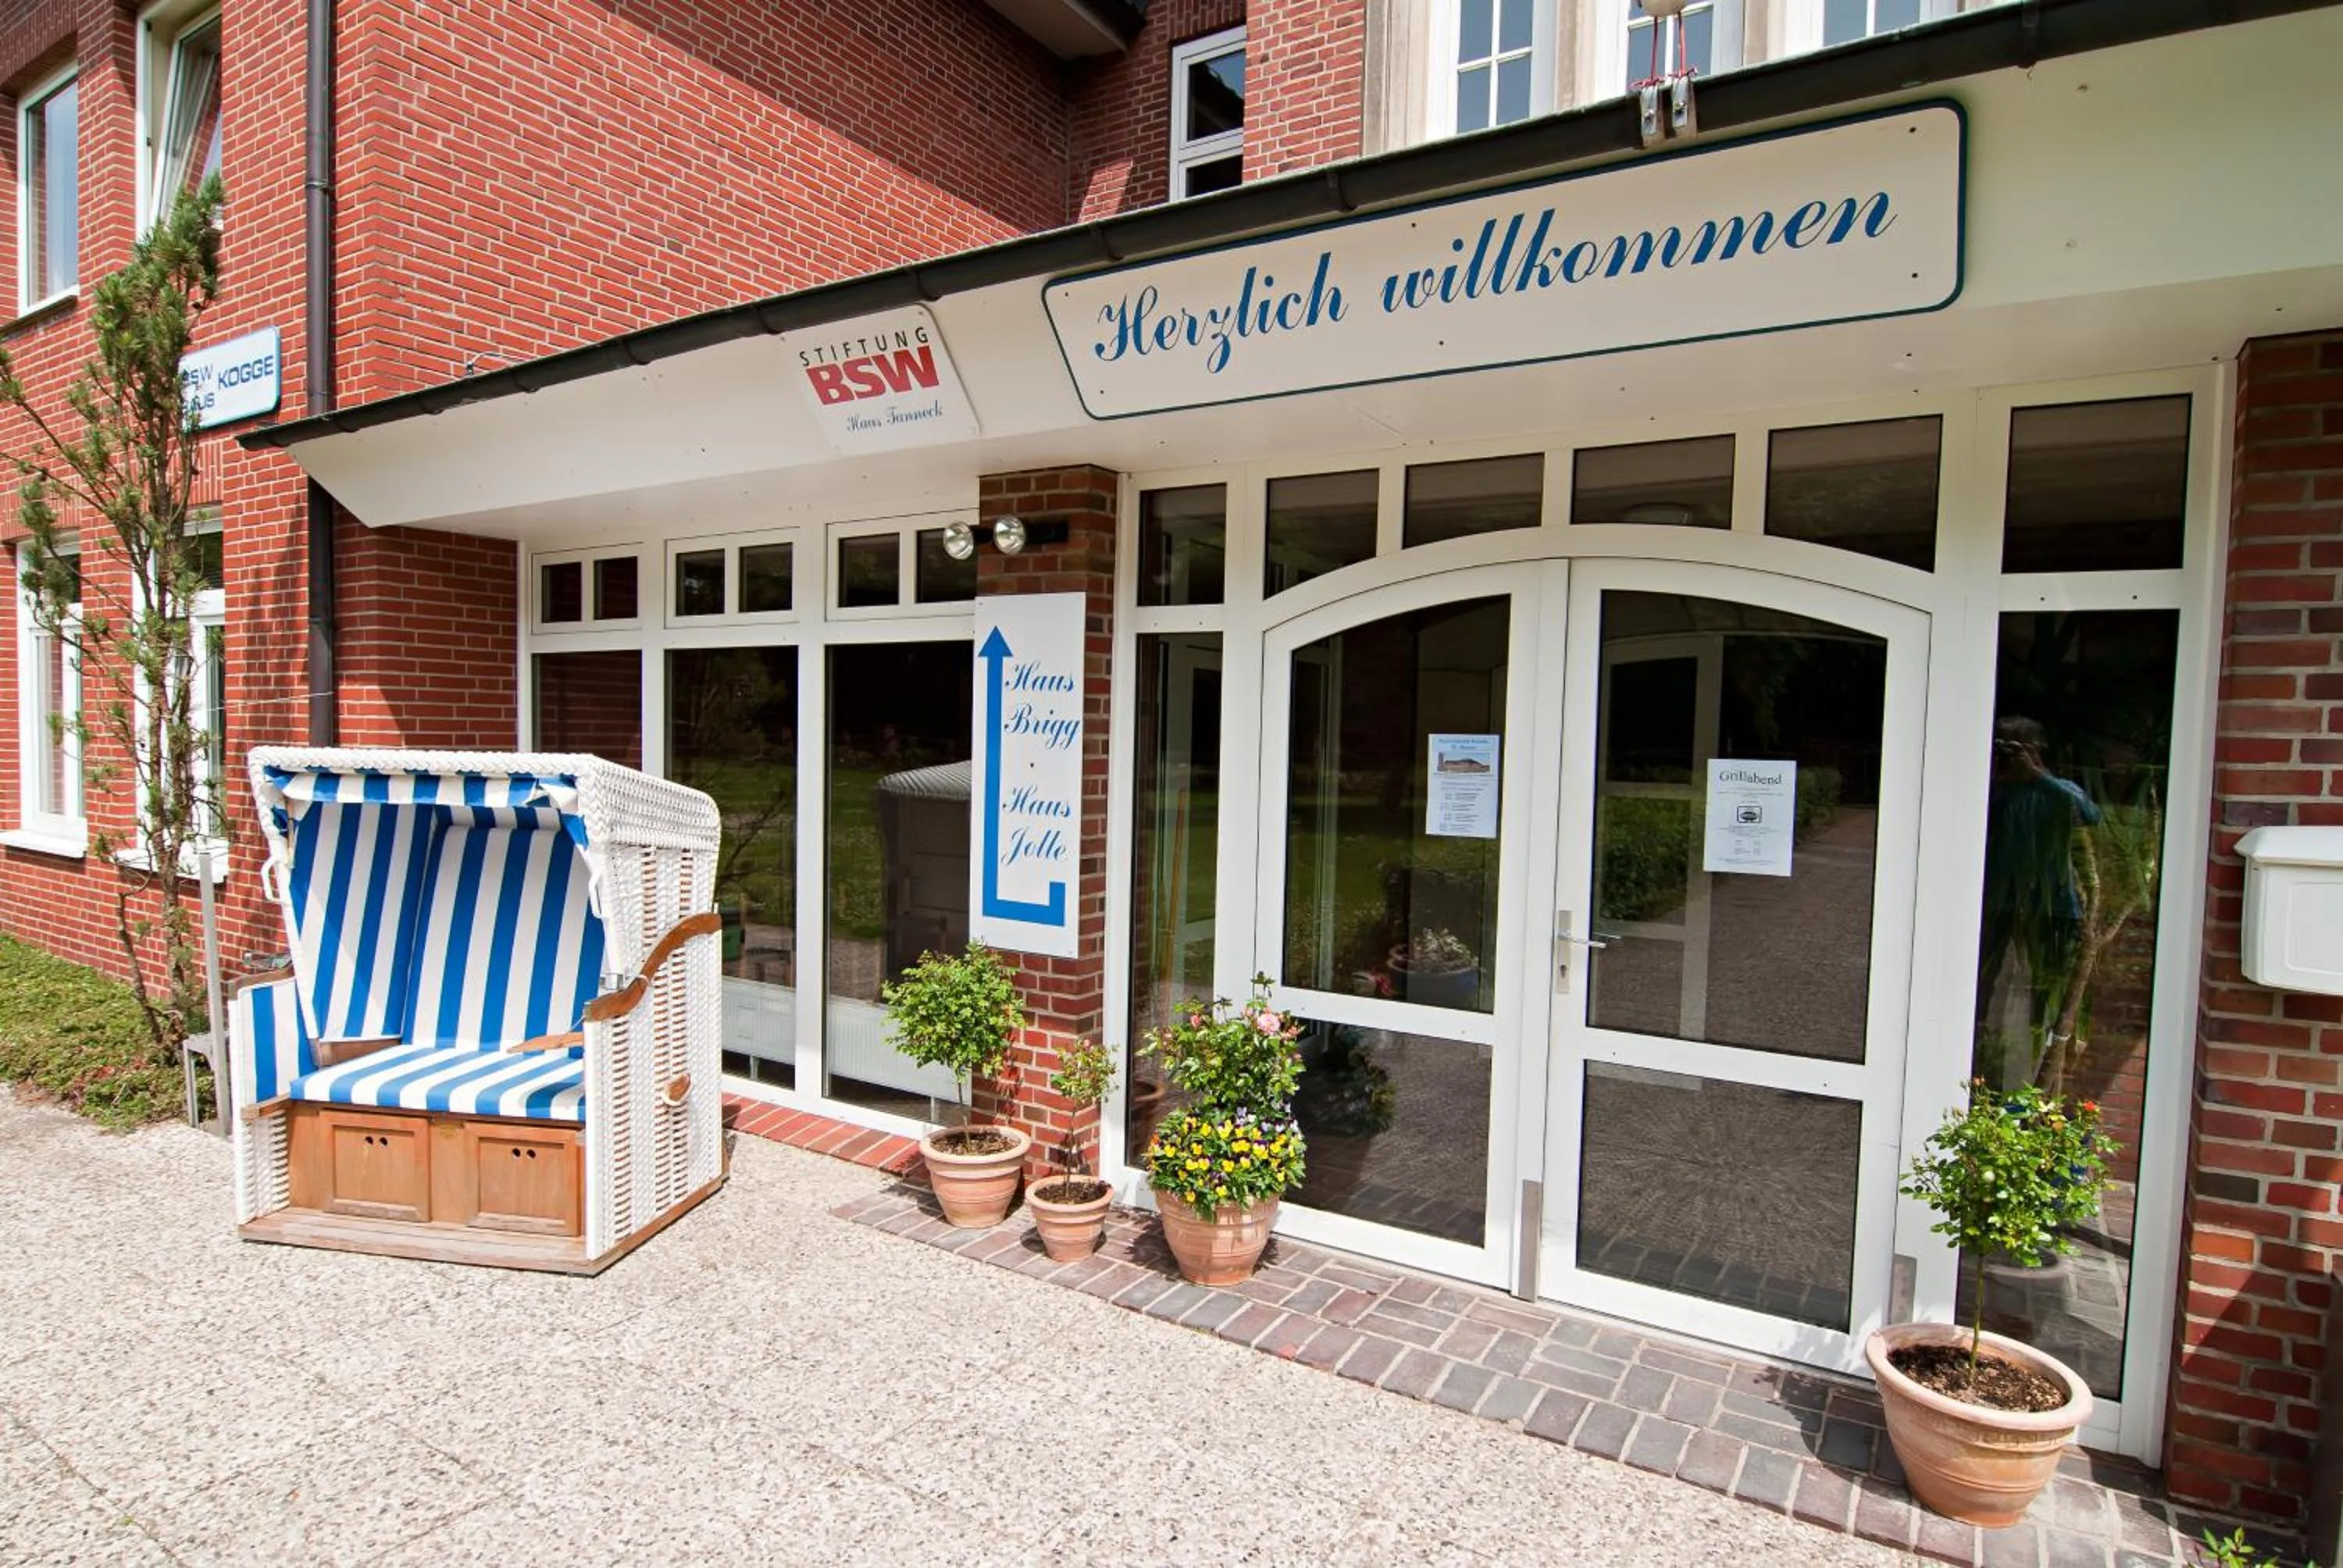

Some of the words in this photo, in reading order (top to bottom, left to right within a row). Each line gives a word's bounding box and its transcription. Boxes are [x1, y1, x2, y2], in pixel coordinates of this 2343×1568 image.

[1094, 252, 1348, 373] Herzlich
[1381, 191, 1898, 312] willkommen
[800, 326, 929, 366] STIFTUNG
[218, 355, 273, 390] KOGGE
[805, 345, 940, 405] BSW
[847, 415, 882, 432] Haus
[1004, 661, 1075, 693] Haus
[1004, 703, 1079, 750] Brigg
[1719, 770, 1782, 786] Grillabend
[1002, 786, 1071, 818] Haus
[1000, 827, 1066, 867] Jolle
